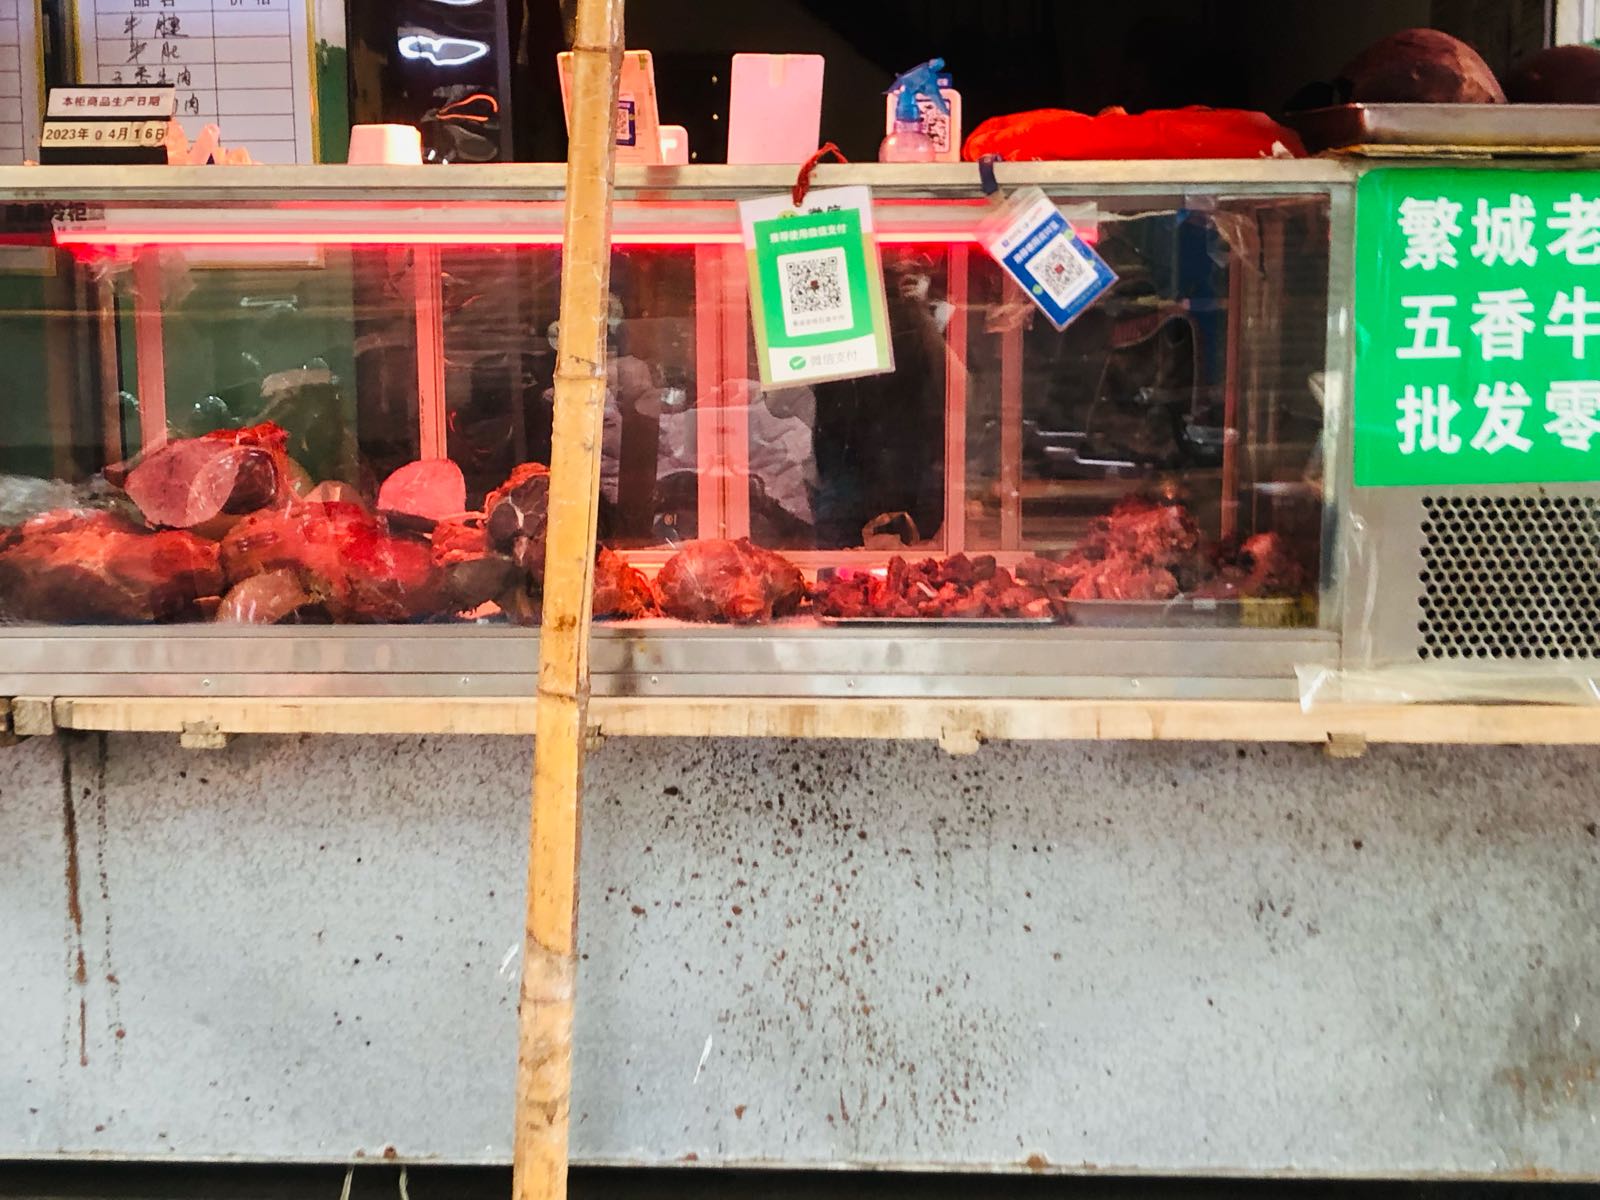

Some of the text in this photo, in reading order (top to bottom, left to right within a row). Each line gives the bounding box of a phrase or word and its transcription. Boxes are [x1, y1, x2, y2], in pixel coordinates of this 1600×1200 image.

[62, 96, 161, 107] 本柜商品生产日期
[1397, 193, 1600, 269] 繁城老
[810, 350, 858, 367] 微信支付
[1396, 287, 1600, 361] 五香牛
[1396, 380, 1600, 455] 批发零
